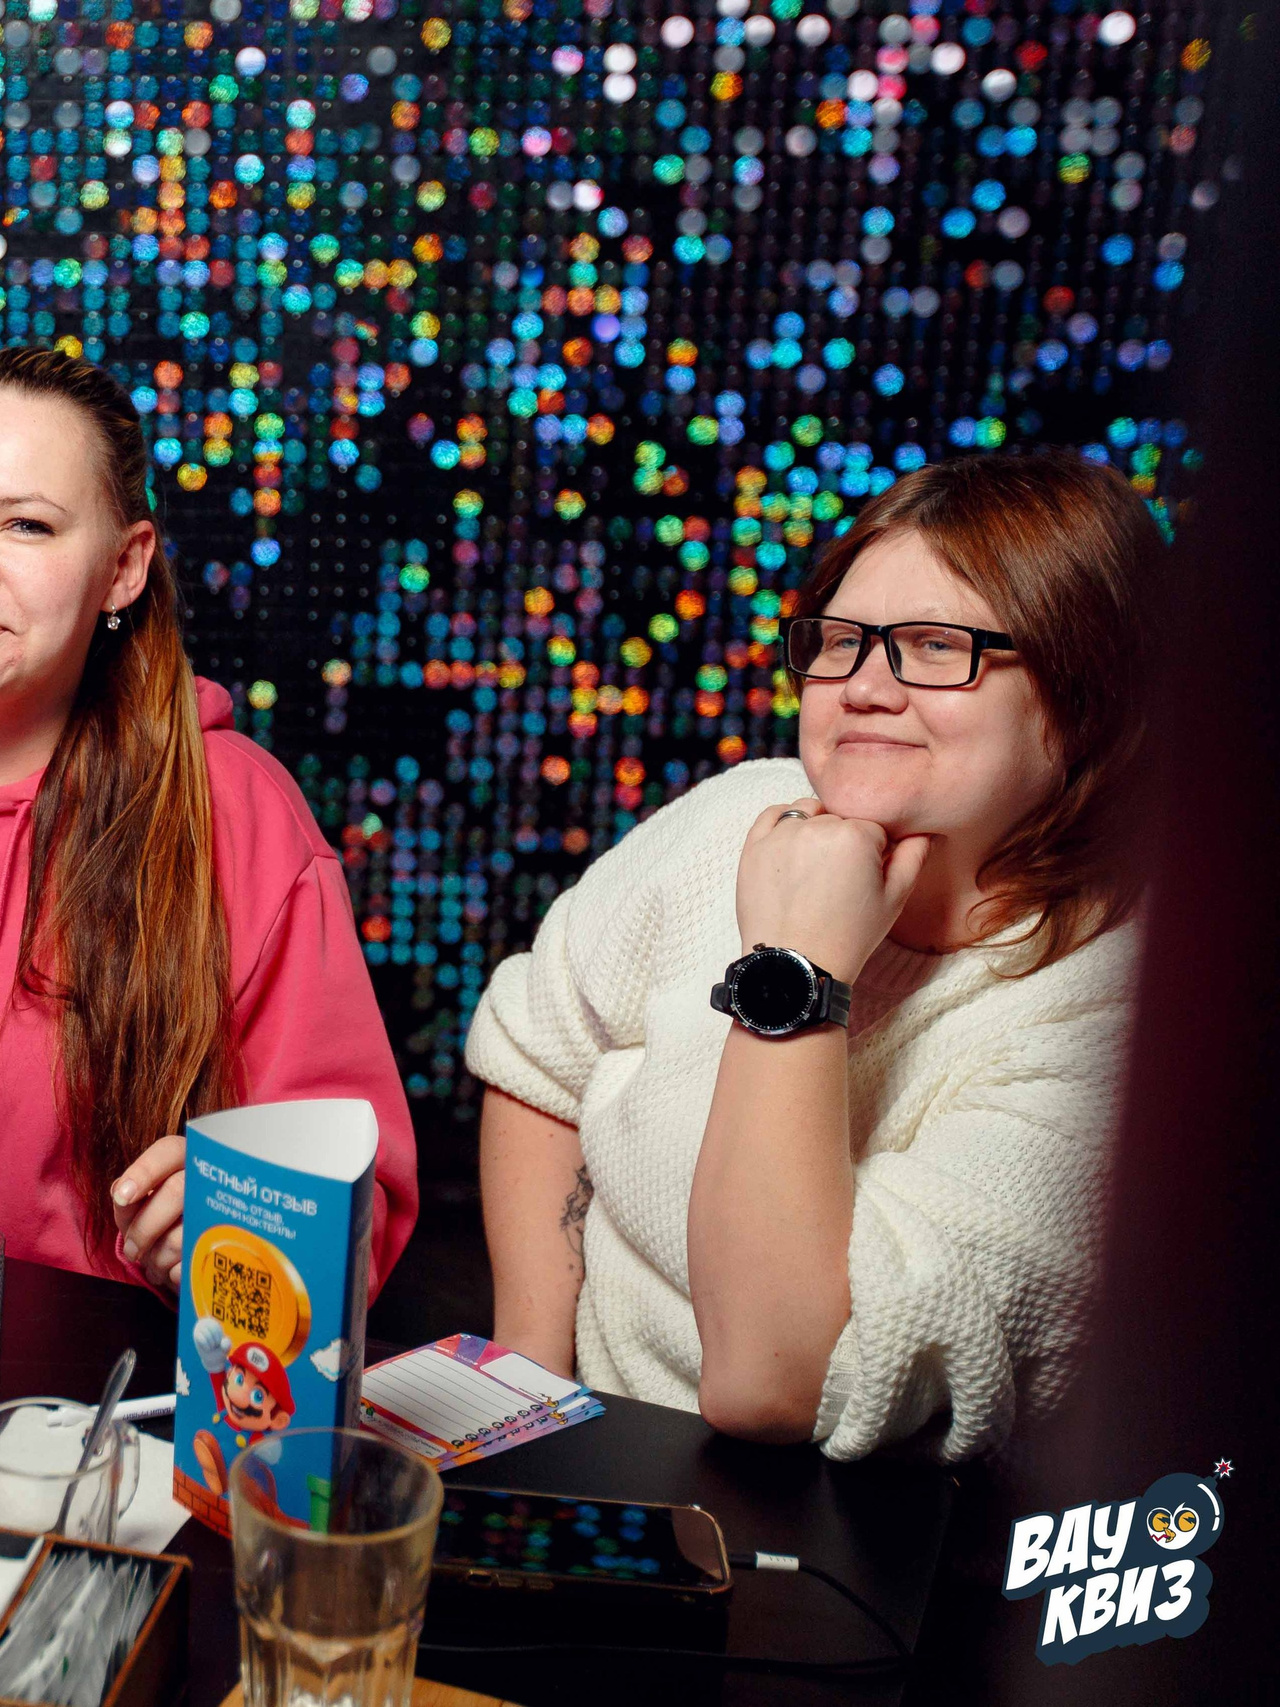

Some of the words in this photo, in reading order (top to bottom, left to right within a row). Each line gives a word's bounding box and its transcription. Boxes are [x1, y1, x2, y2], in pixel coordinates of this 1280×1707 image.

[194, 1156, 257, 1198] ЧЕСТНЫЙ
[261, 1187, 317, 1216] ОТЗЫВ
[206, 1196, 241, 1220] ПОЛУЧИ
[216, 1190, 248, 1212] ОСТАВЬ
